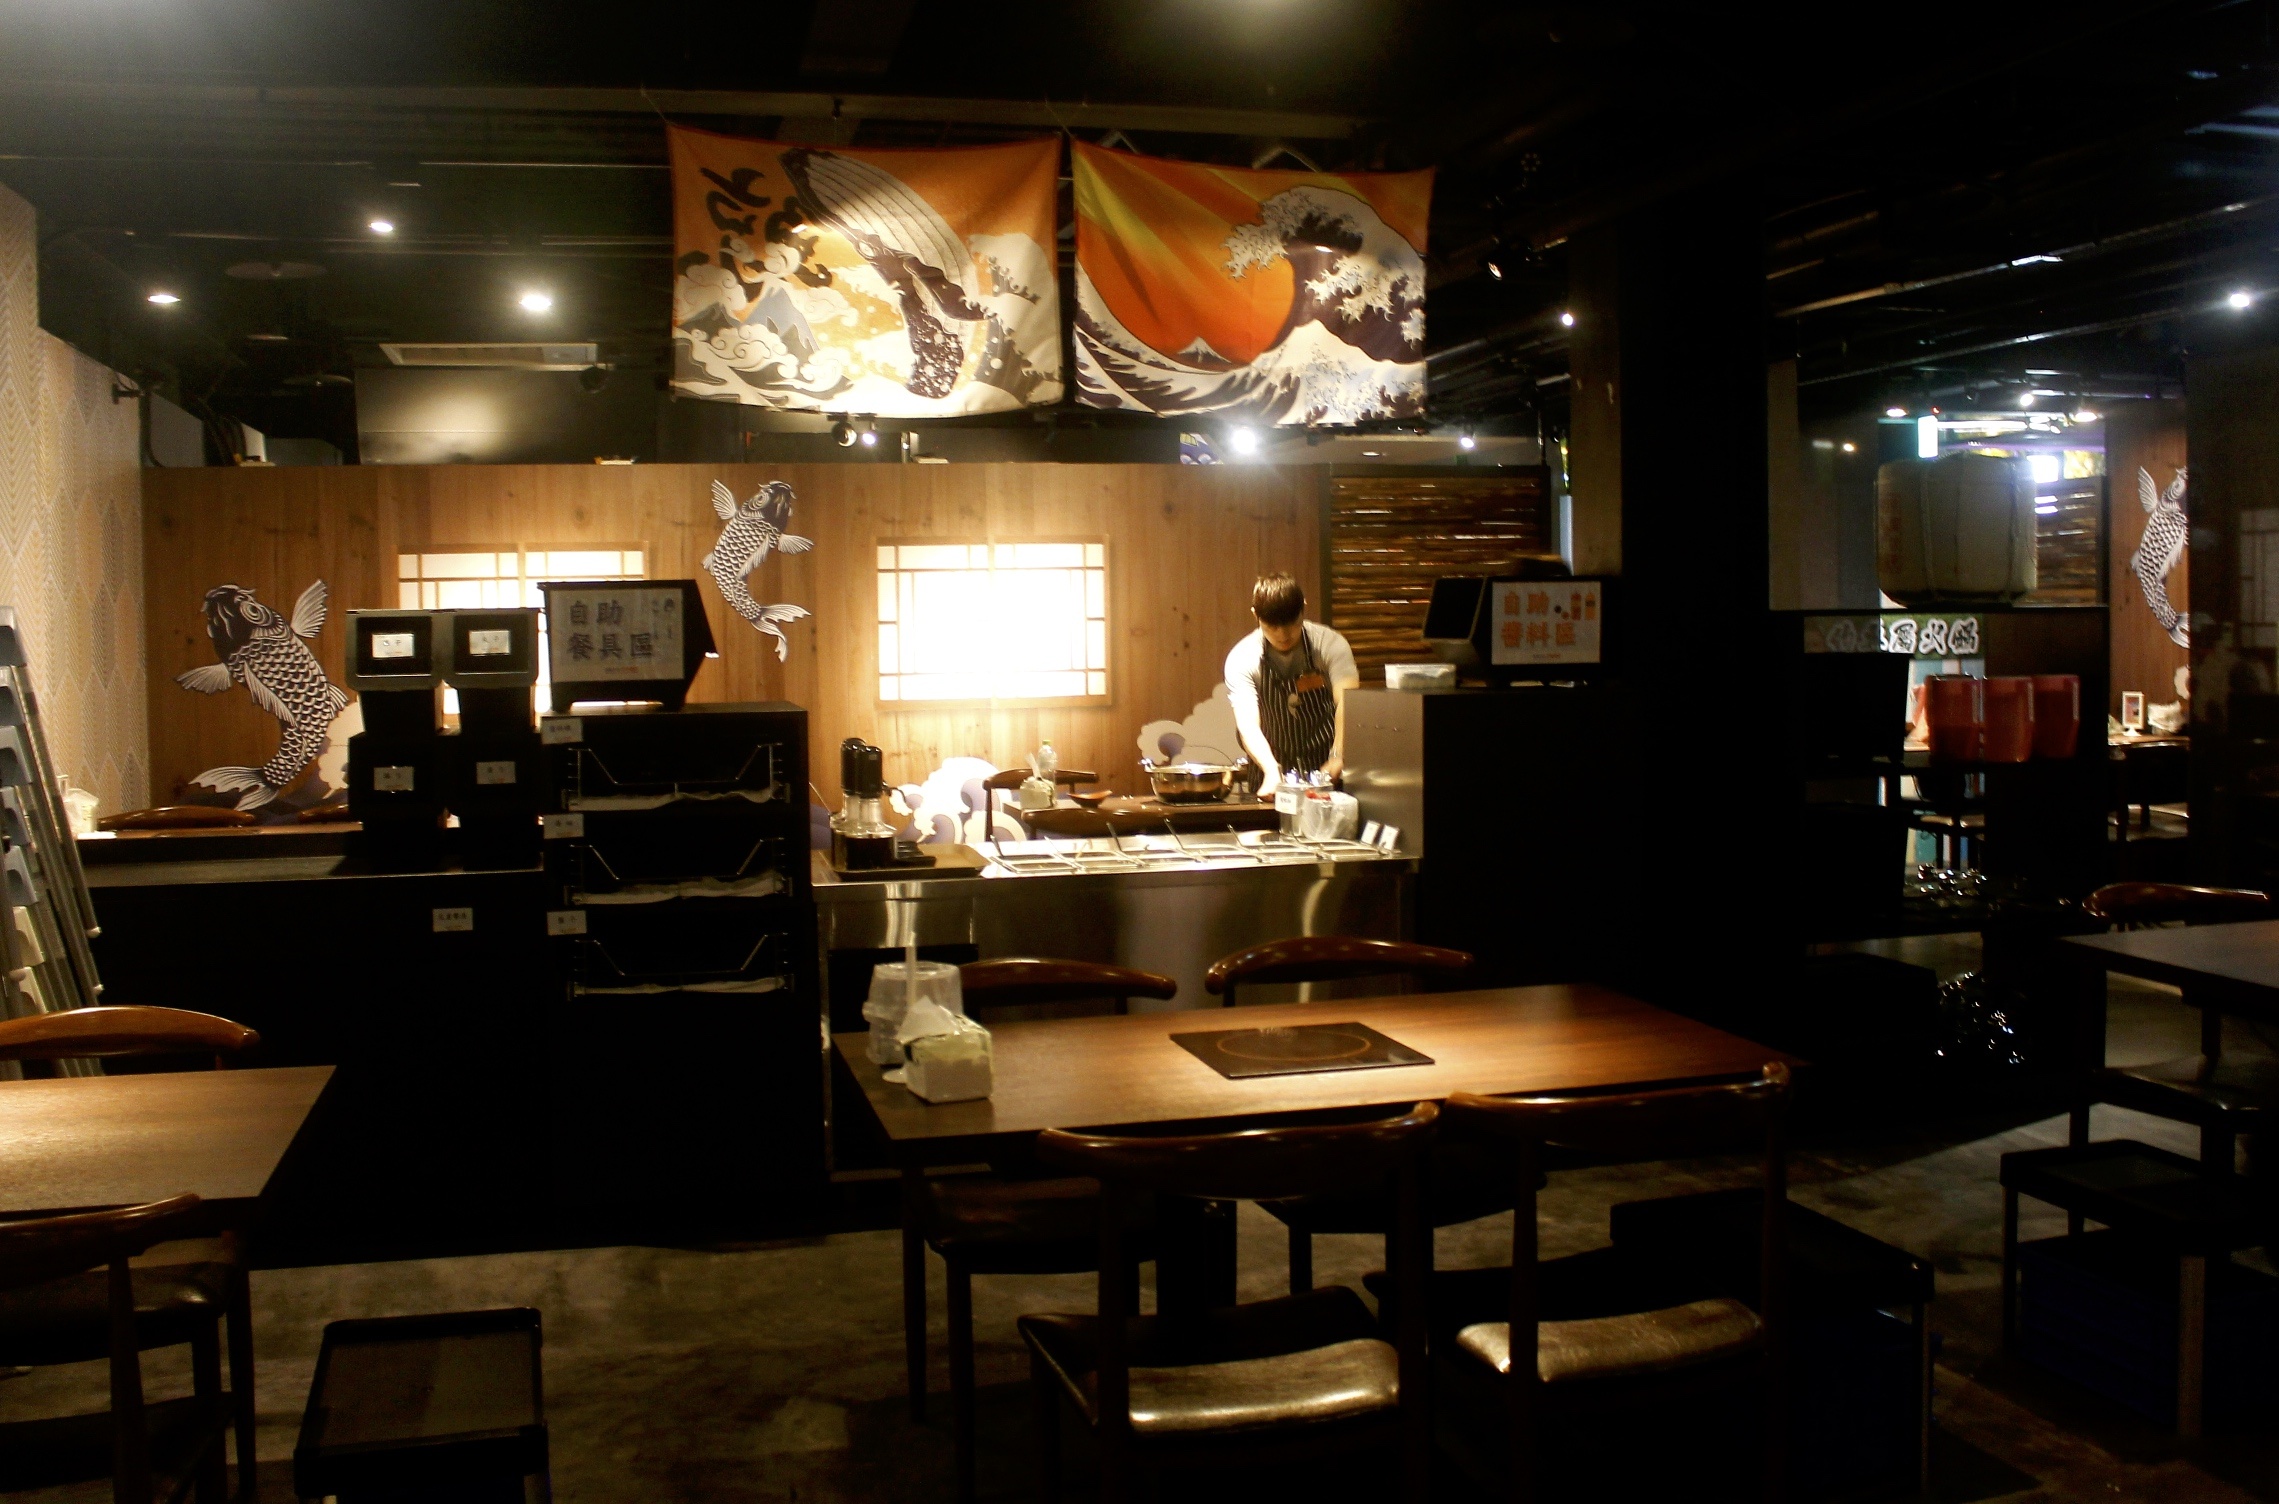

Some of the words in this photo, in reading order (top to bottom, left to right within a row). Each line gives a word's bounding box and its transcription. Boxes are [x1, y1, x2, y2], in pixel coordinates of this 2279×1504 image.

[570, 600, 624, 625] 自助
[1504, 591, 1549, 615] 自助
[568, 631, 652, 660] 餐具區
